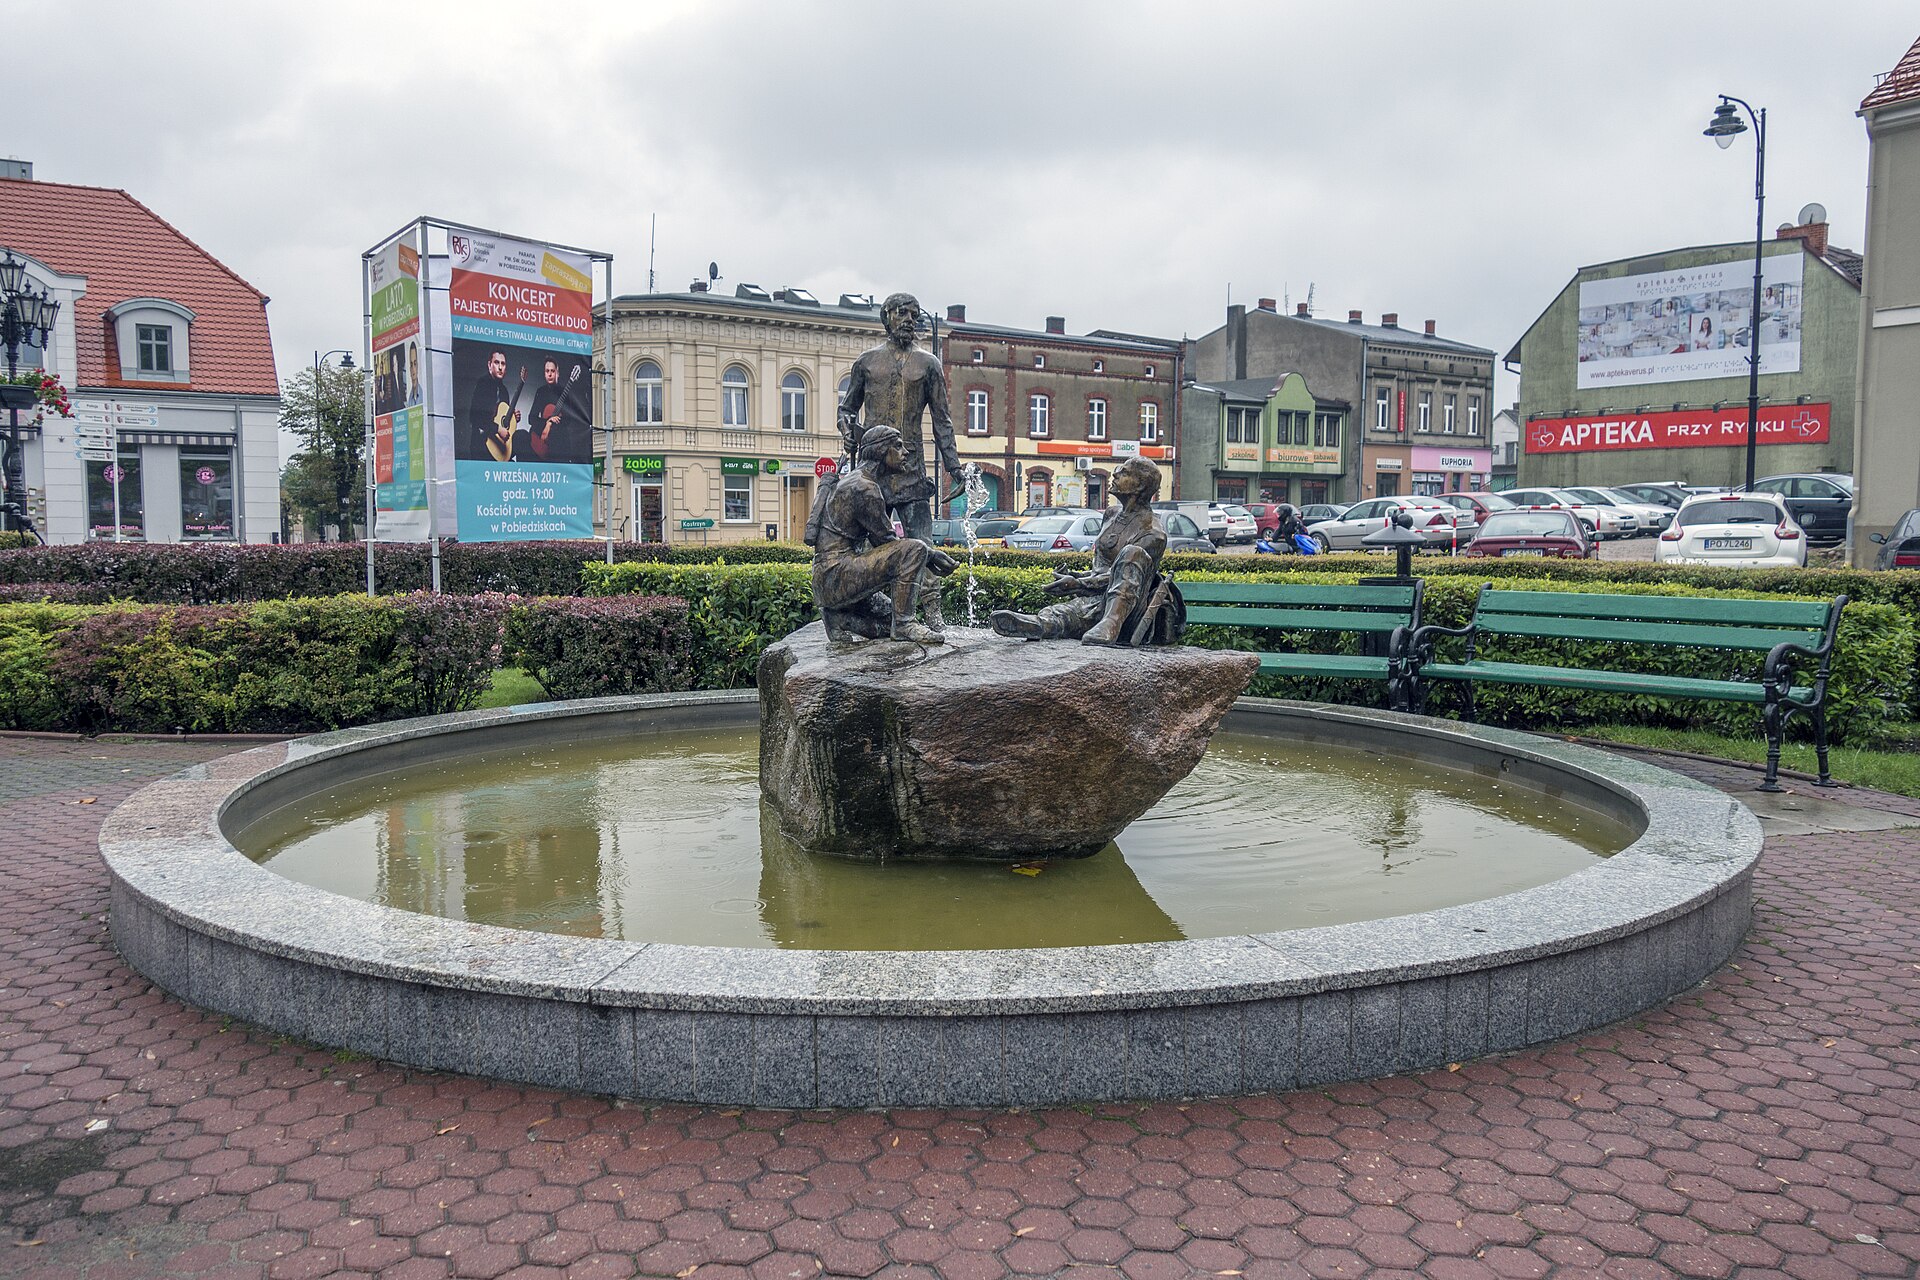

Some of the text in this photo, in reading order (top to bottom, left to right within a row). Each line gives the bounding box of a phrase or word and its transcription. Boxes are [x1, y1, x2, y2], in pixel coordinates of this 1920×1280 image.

[521, 259, 536, 267] DUCHA
[545, 260, 579, 288] zapraszają
[1636, 271, 1723, 289] apteka verus
[385, 281, 404, 312] LATO
[488, 281, 556, 309] KONCERT
[453, 298, 508, 318] PAJESTKA
[516, 308, 565, 327] KOSTECKI
[566, 317, 588, 331] DUO
[454, 323, 589, 349] W RAMACH FESTIWALU AKADEMII GITARY
[1590, 367, 1655, 379] www.aptekaverus.pl
[1559, 420, 1655, 446] APTEKA
[1667, 423, 1713, 437] PRZY
[1121, 443, 1135, 451] abc
[1231, 451, 1255, 459] szkolne
[1277, 453, 1309, 462] biurowe
[625, 457, 662, 469] żabka
[1441, 458, 1473, 466] EUPHORIA
[816, 464, 835, 473] STOP
[484, 468, 569, 484] 9 WRZEŚNIA 2017 r.
[502, 488, 554, 501] godz. 19:00
[476, 503, 577, 518] Kościół pw. św. Ducha
[491, 521, 566, 533] w Pobiedziskach
[1724, 540, 1750, 548] 7L246
